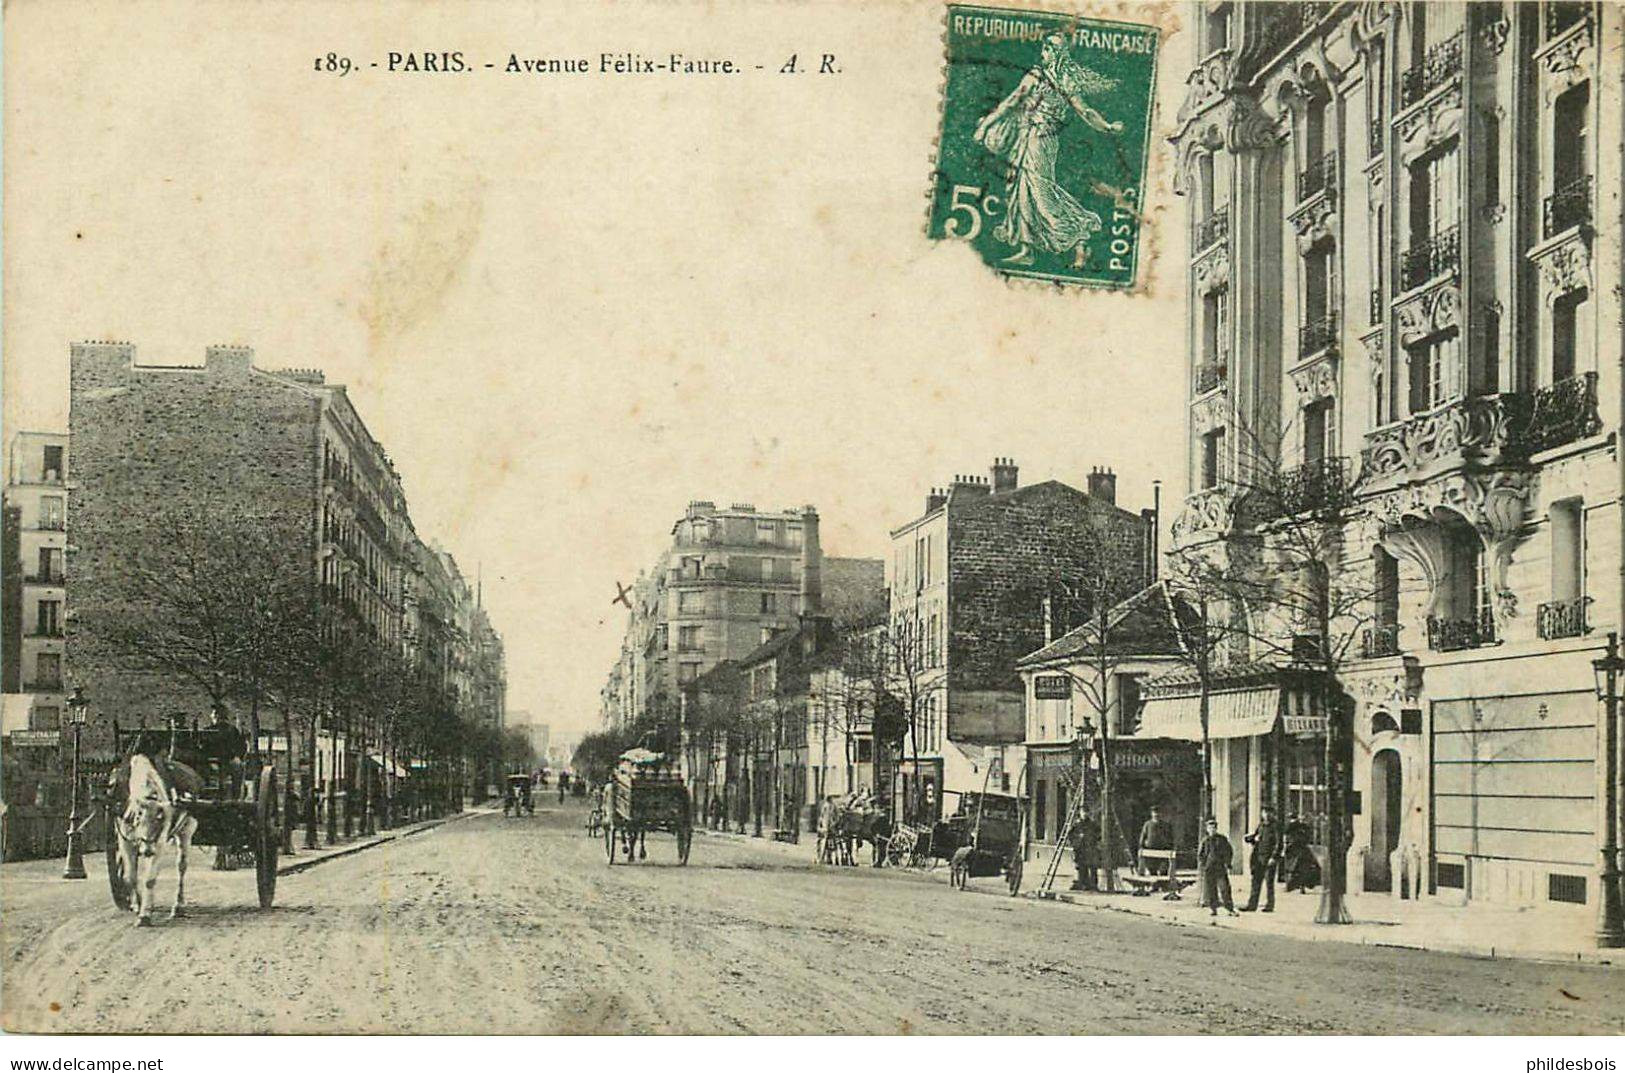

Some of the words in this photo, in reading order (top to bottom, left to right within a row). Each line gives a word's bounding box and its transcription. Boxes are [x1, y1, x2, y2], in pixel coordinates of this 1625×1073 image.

[313, 52, 359, 77] 189.
[388, 52, 472, 72] PARIS.
[505, 53, 589, 73] Avenue
[600, 53, 740, 74] Félix-Faure.
